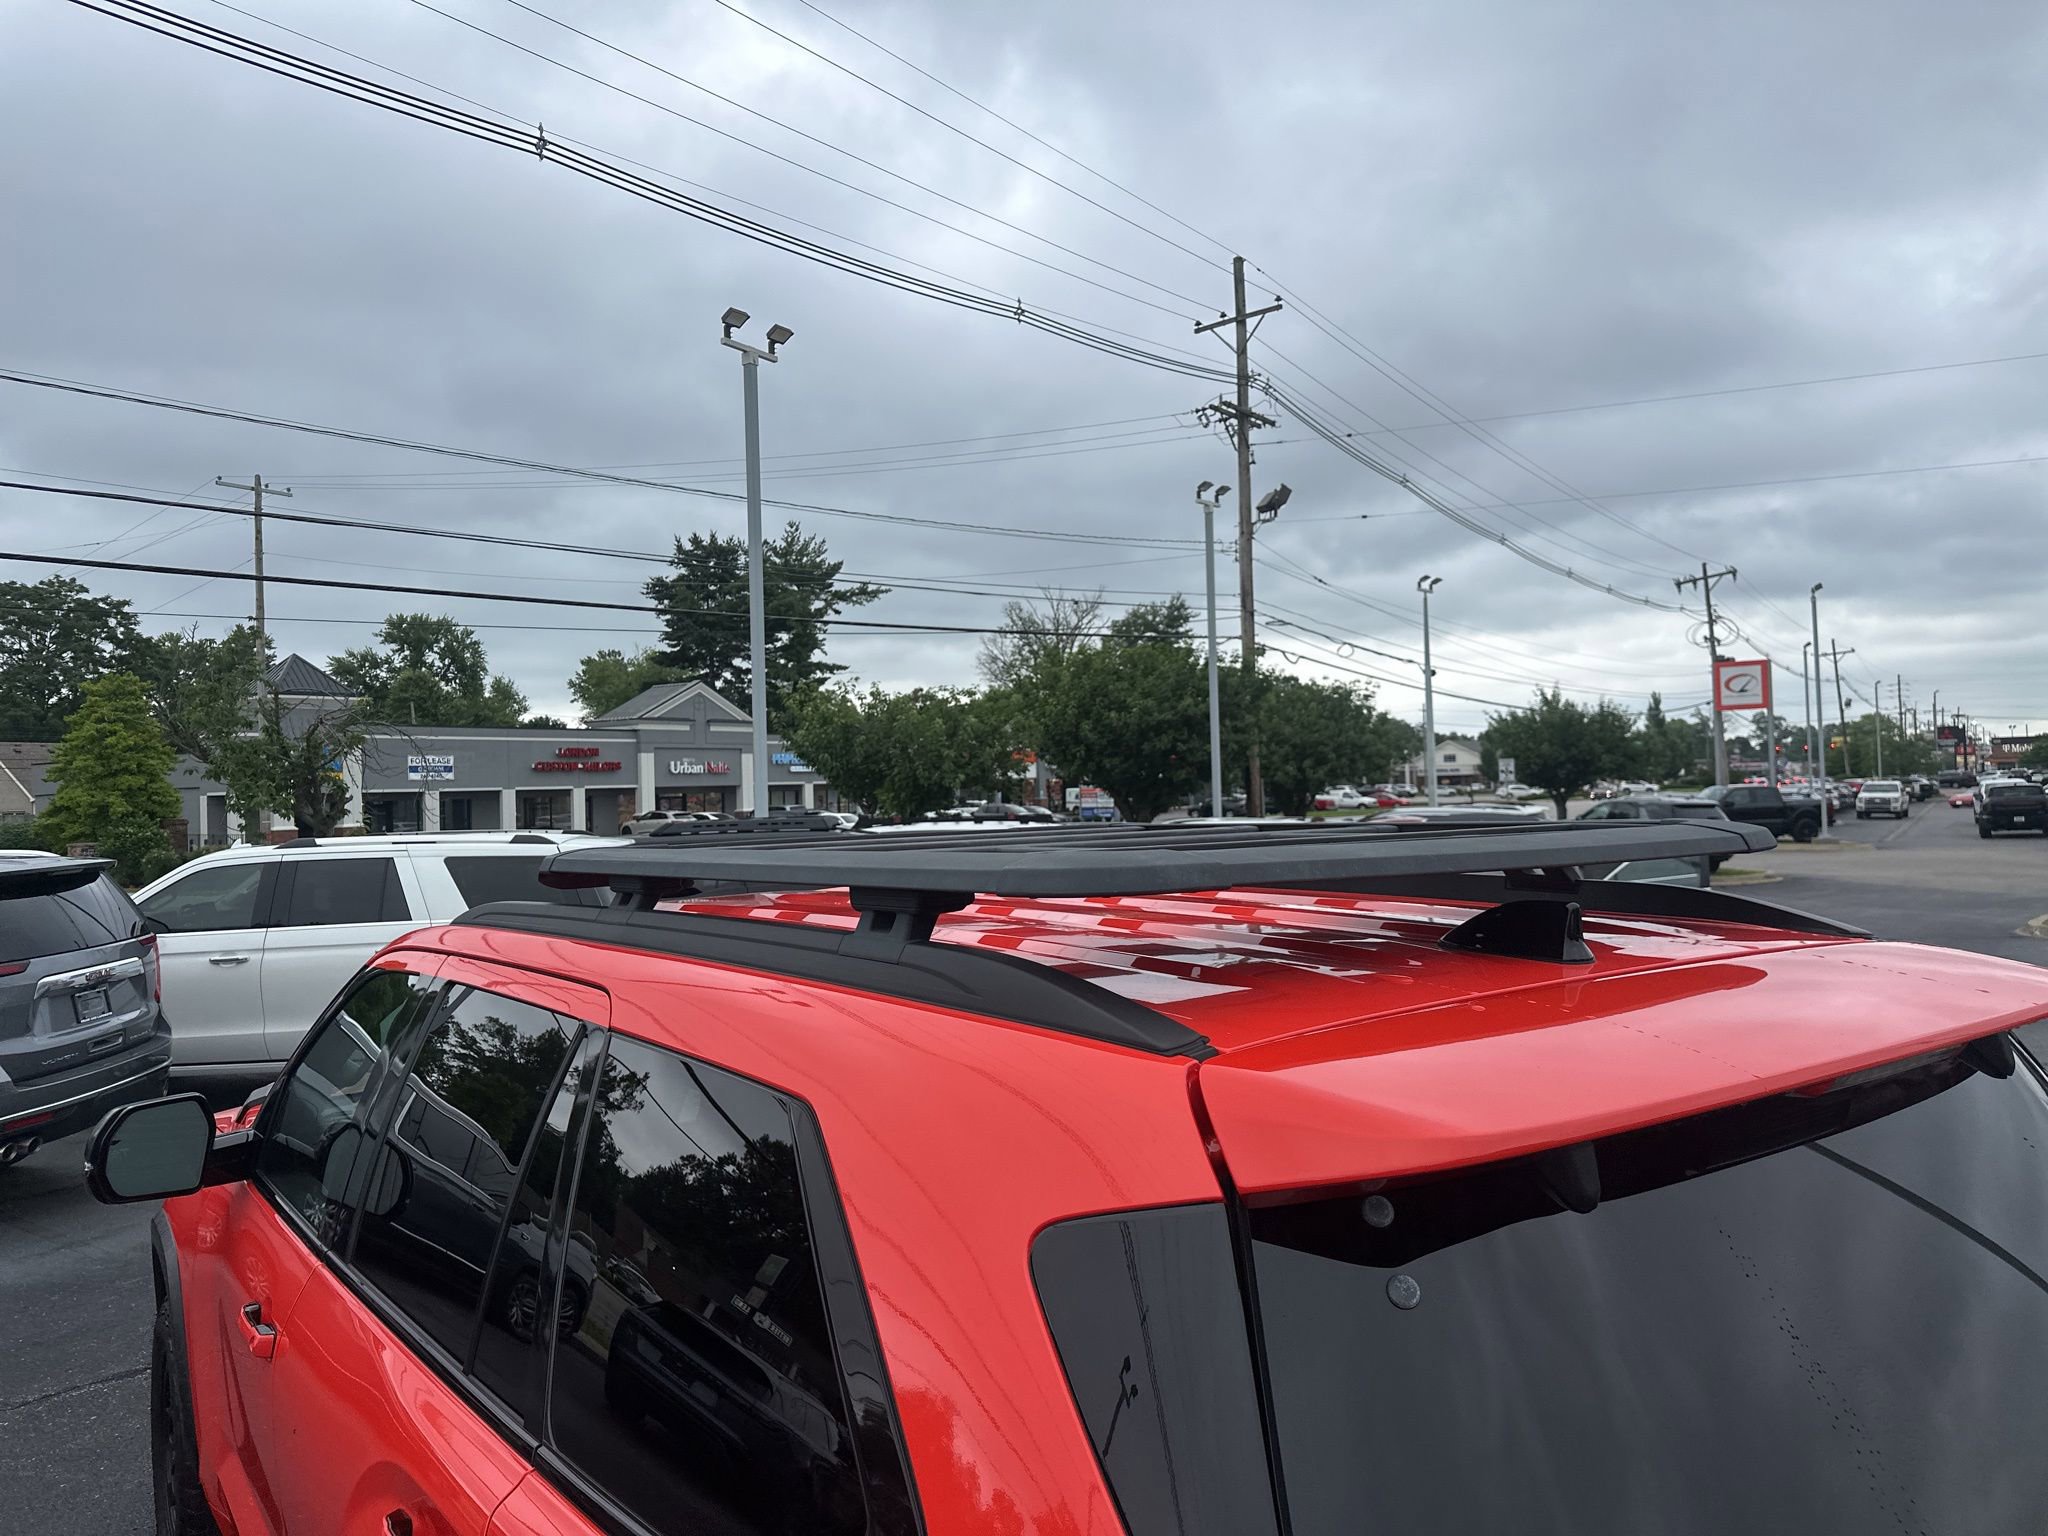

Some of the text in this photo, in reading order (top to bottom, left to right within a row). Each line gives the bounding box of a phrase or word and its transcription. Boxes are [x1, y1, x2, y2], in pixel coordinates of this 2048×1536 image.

[410, 757, 452, 765] FOR LEASE
[669, 760, 731, 774] Urban Nails
